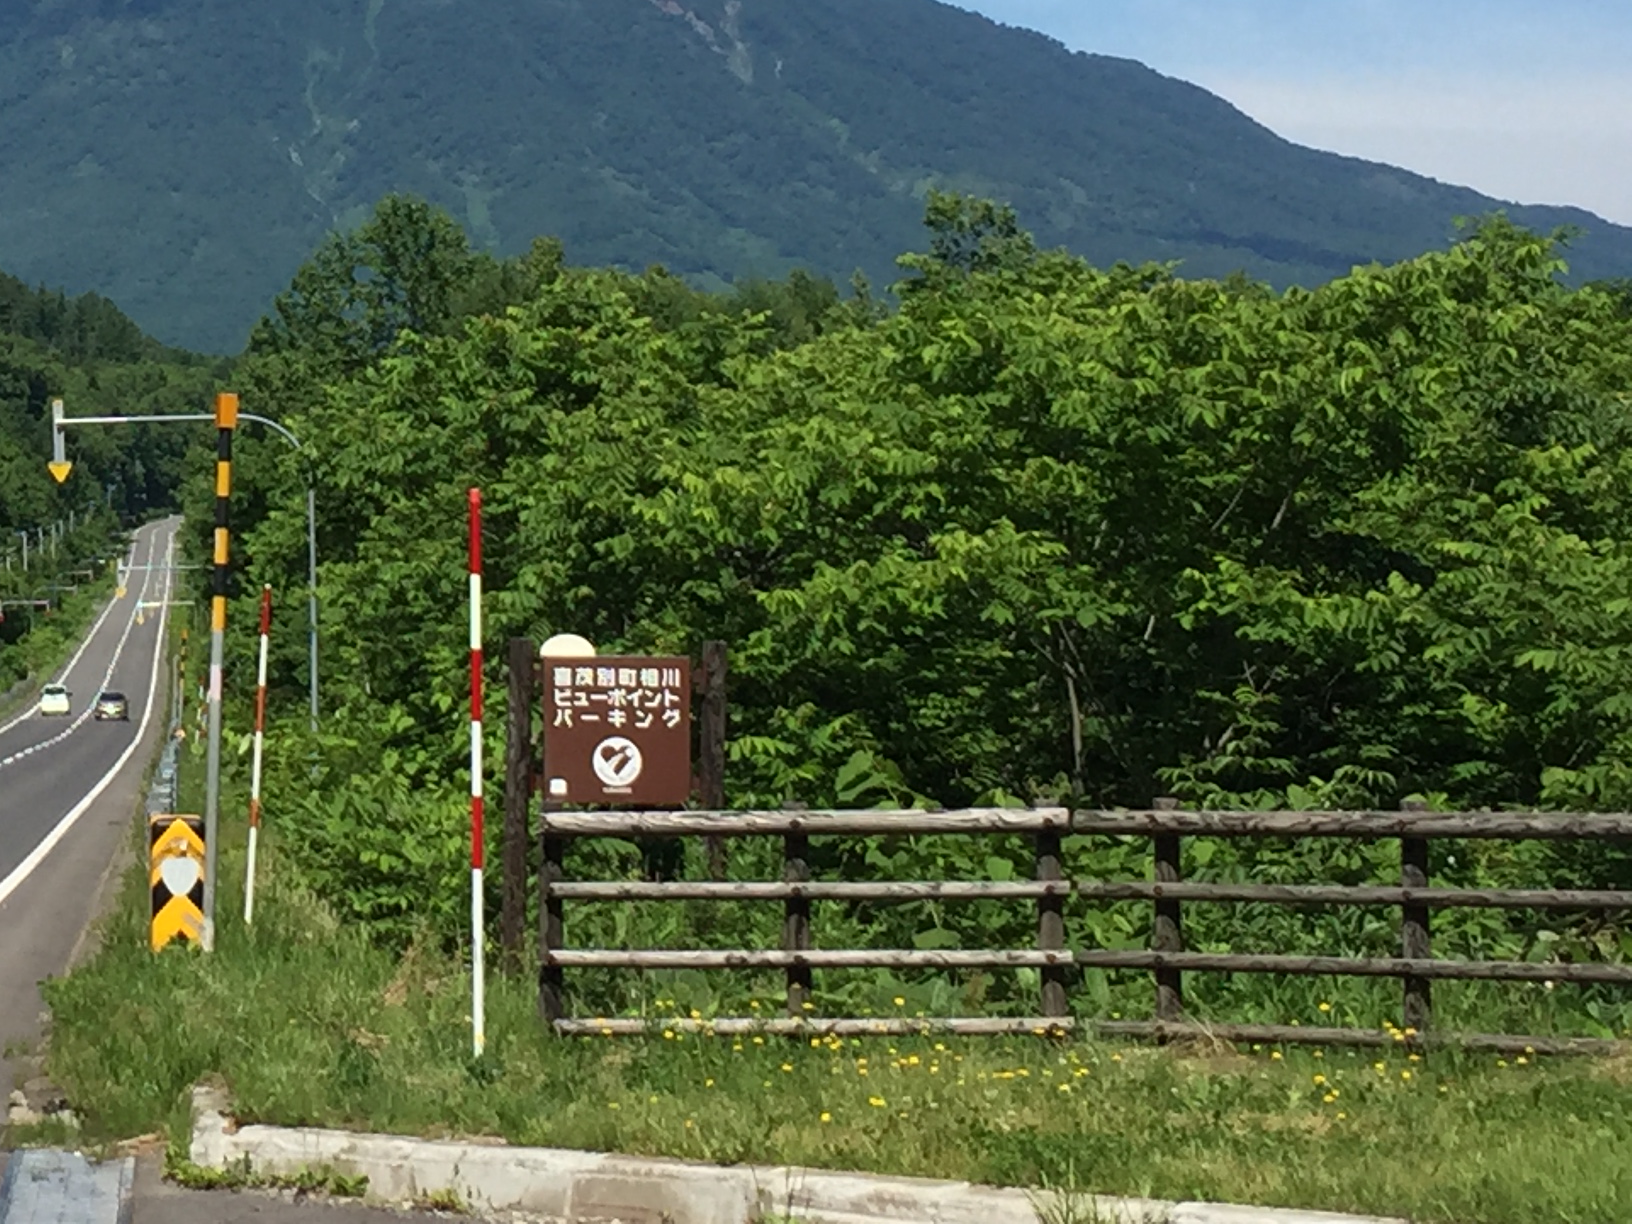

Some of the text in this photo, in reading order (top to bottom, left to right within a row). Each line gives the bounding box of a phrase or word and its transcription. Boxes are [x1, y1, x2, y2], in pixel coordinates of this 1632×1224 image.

[553, 688, 680, 707] ビューポイント
[553, 709, 681, 728] パーキング
